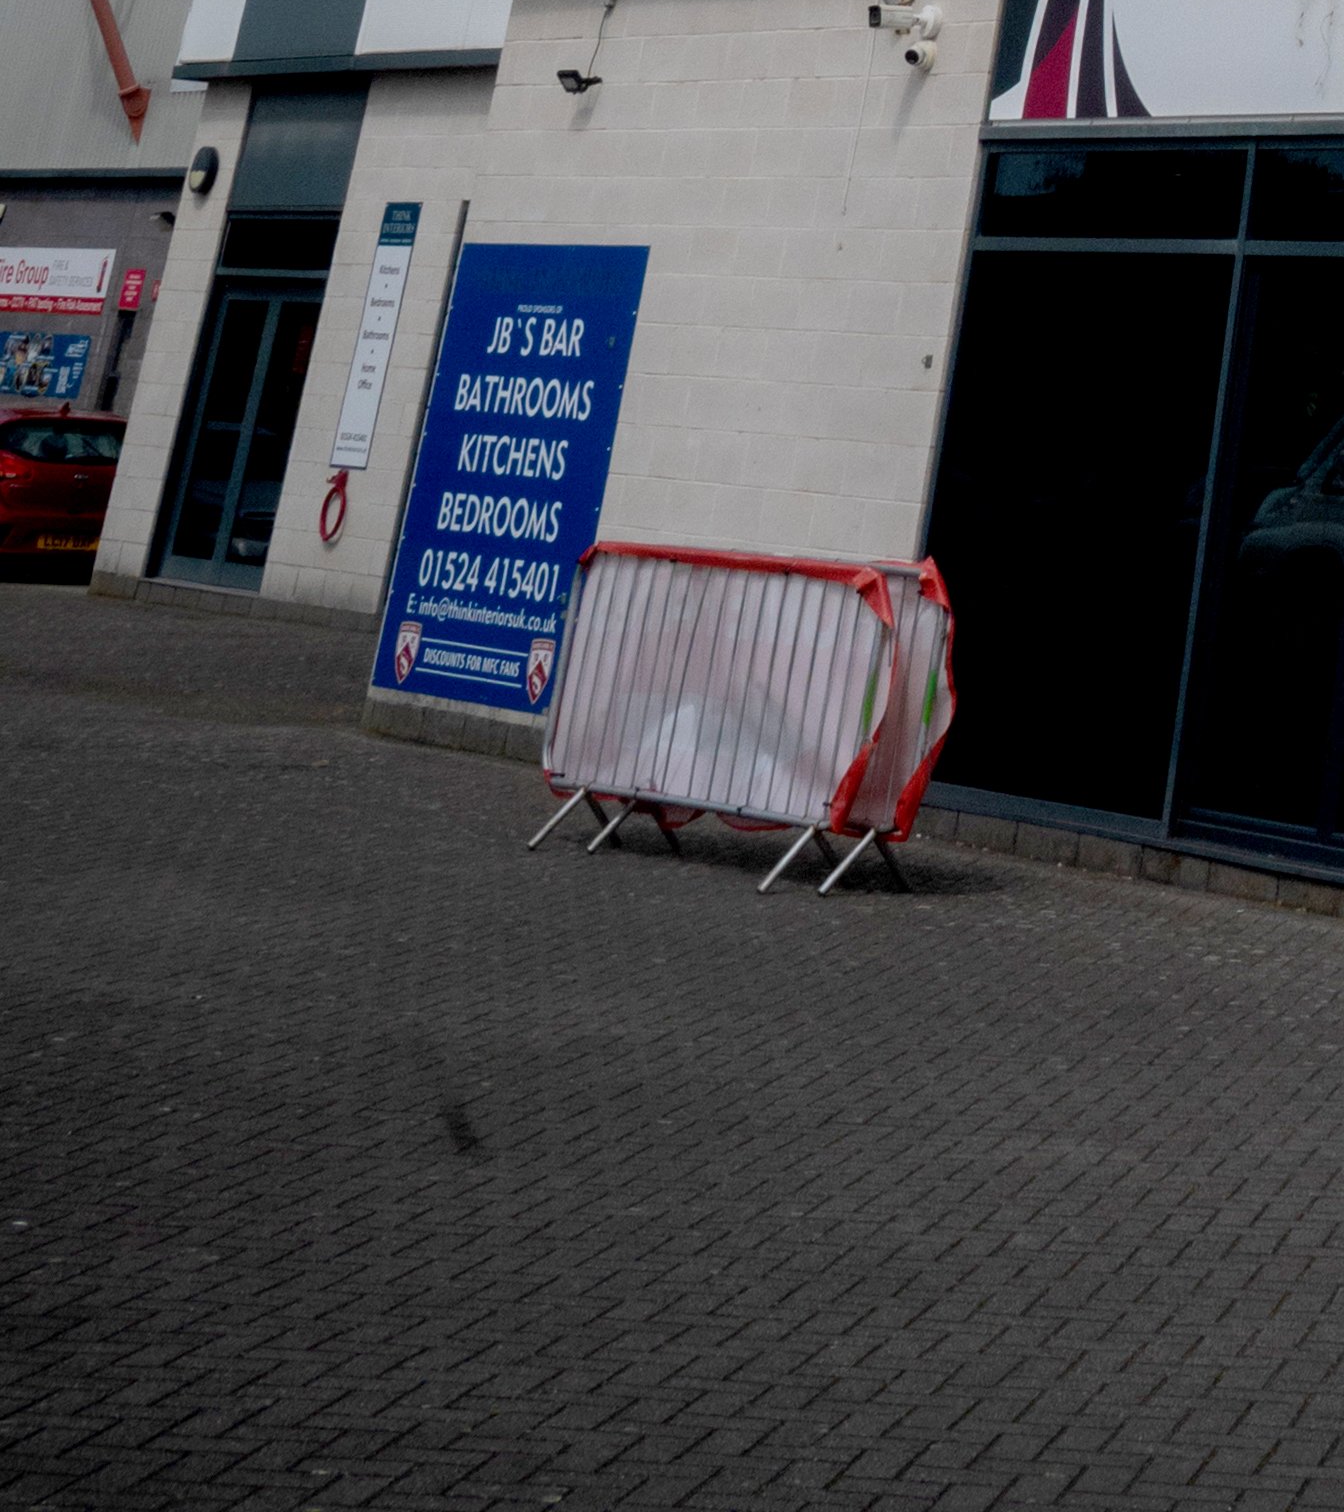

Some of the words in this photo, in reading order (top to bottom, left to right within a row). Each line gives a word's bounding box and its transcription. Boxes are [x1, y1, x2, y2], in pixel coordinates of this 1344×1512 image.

[16, 259, 49, 291] Group
[538, 318, 585, 357] BAR
[454, 374, 595, 421] BATHROOMS
[457, 434, 569, 480] KITCHENS
[437, 491, 563, 543] BEDROOMS
[418, 548, 482, 593] 01524
[484, 556, 560, 603] 415401
[406, 593, 418, 614] E:
[418, 595, 556, 633] info@thinkinteriorsuk.co.uk
[423, 647, 466, 670] DISCOUNTS
[466, 655, 481, 672] FOR
[481, 657, 500, 676] MFC
[499, 660, 520, 678] FANS
